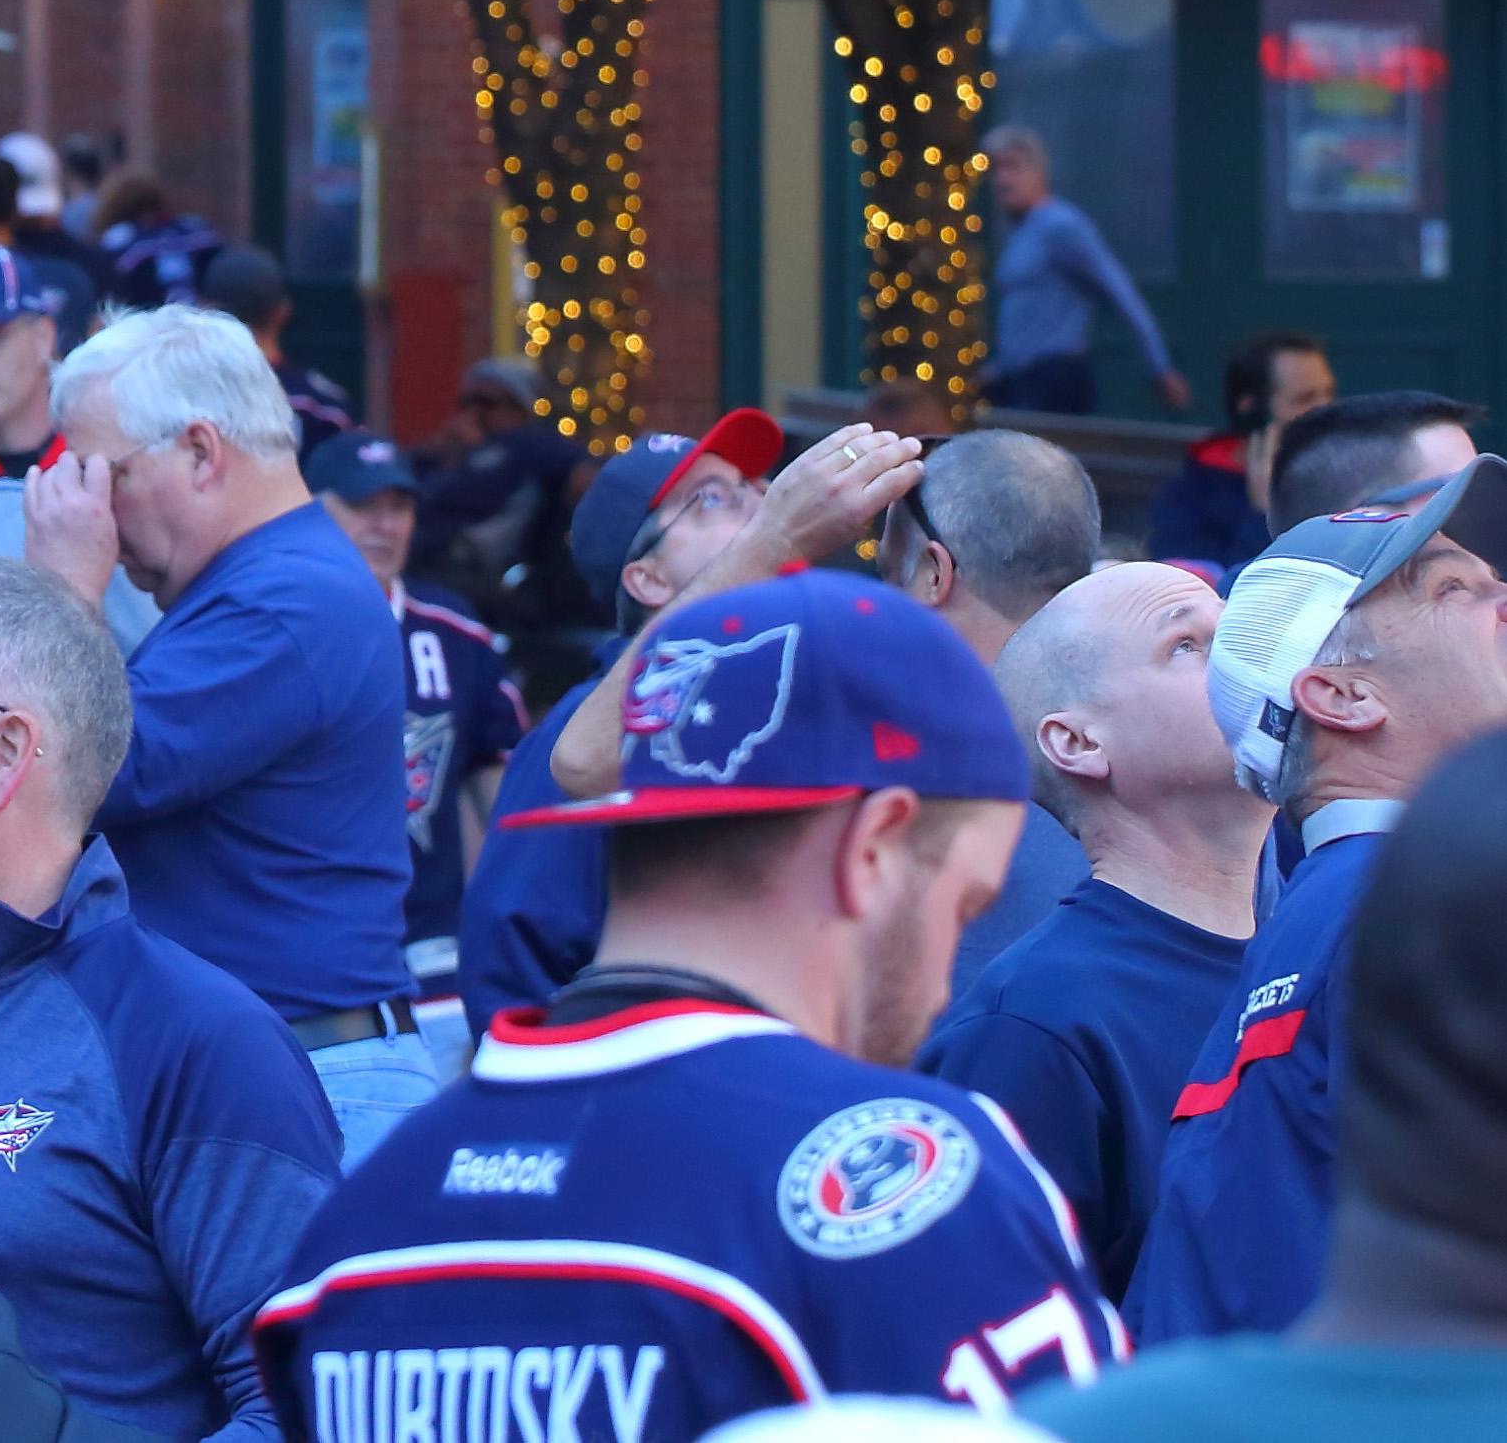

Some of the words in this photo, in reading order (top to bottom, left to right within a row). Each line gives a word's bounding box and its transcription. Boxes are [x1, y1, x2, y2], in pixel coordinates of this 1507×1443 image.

[408, 629, 451, 700] A
[442, 1147, 565, 1196] Reebok
[941, 1283, 1099, 1418] 17
